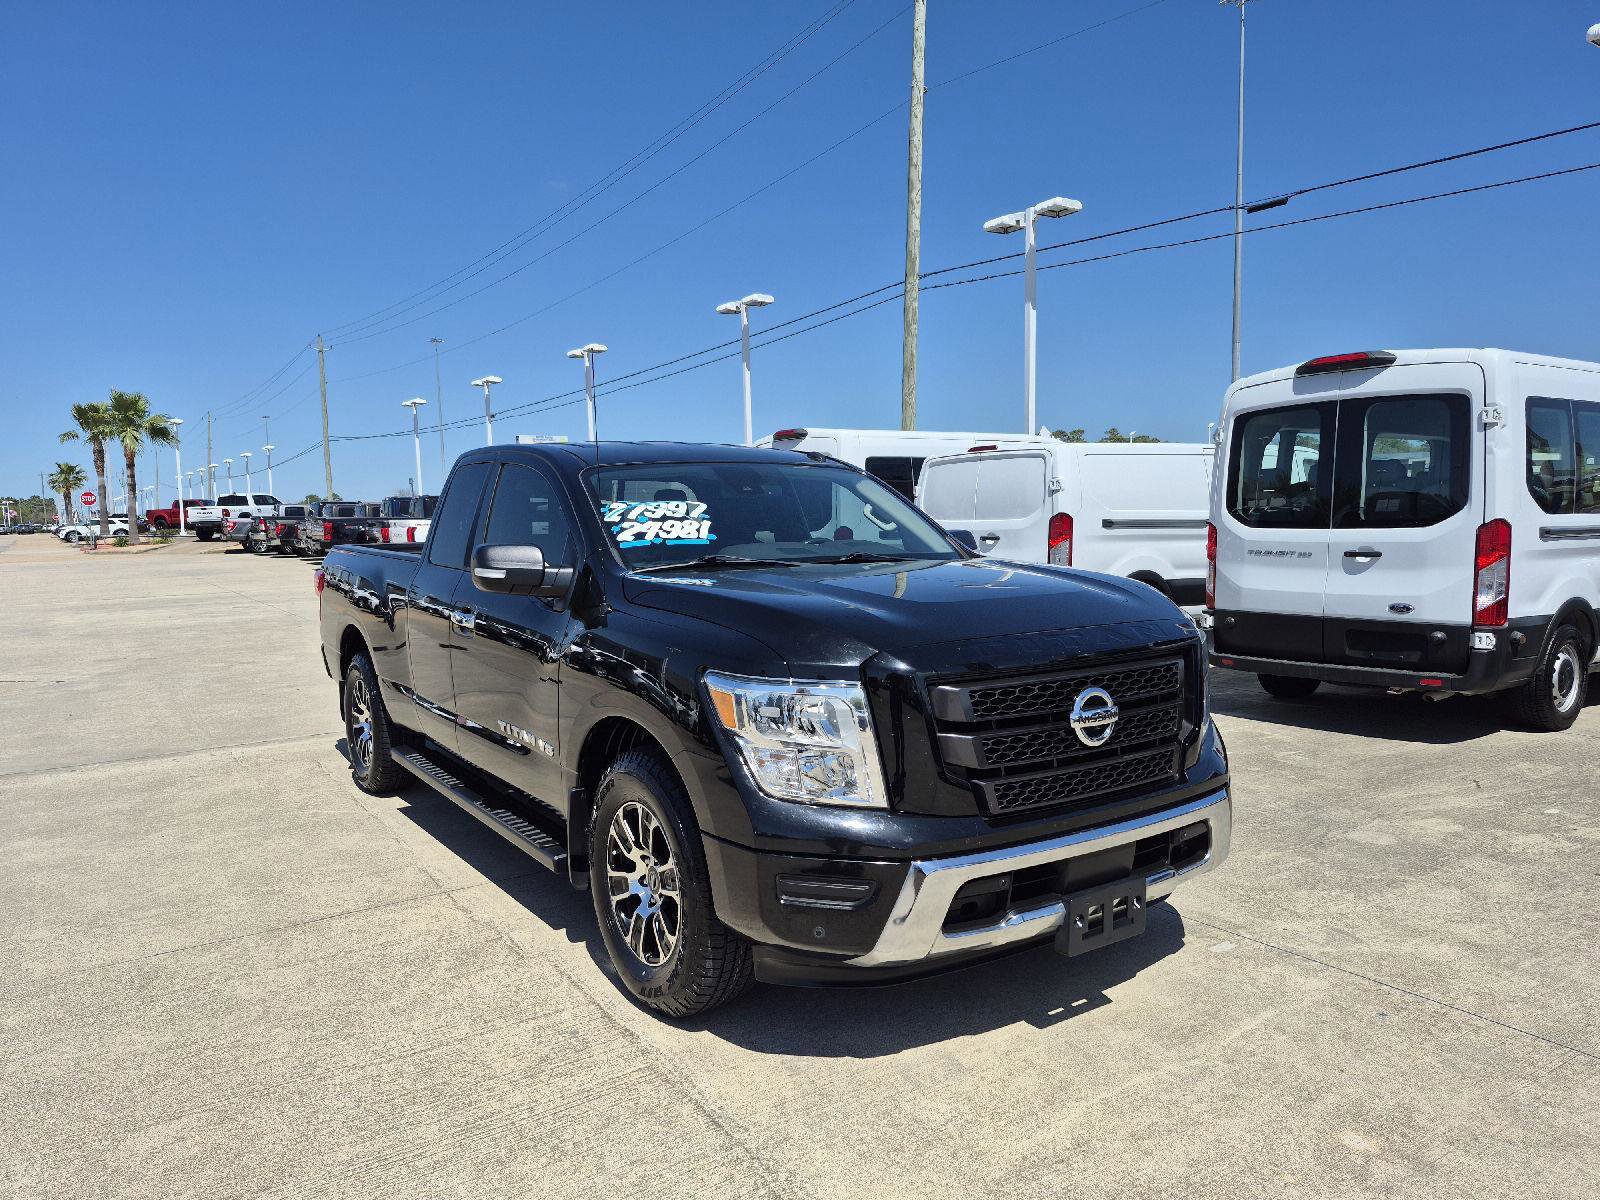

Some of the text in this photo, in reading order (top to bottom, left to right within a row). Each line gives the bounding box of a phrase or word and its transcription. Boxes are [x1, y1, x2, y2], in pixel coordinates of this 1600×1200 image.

[1247, 549, 1296, 558] TRANSIT
[1076, 708, 1117, 724] NISSAN
[498, 719, 536, 747] TITAN
